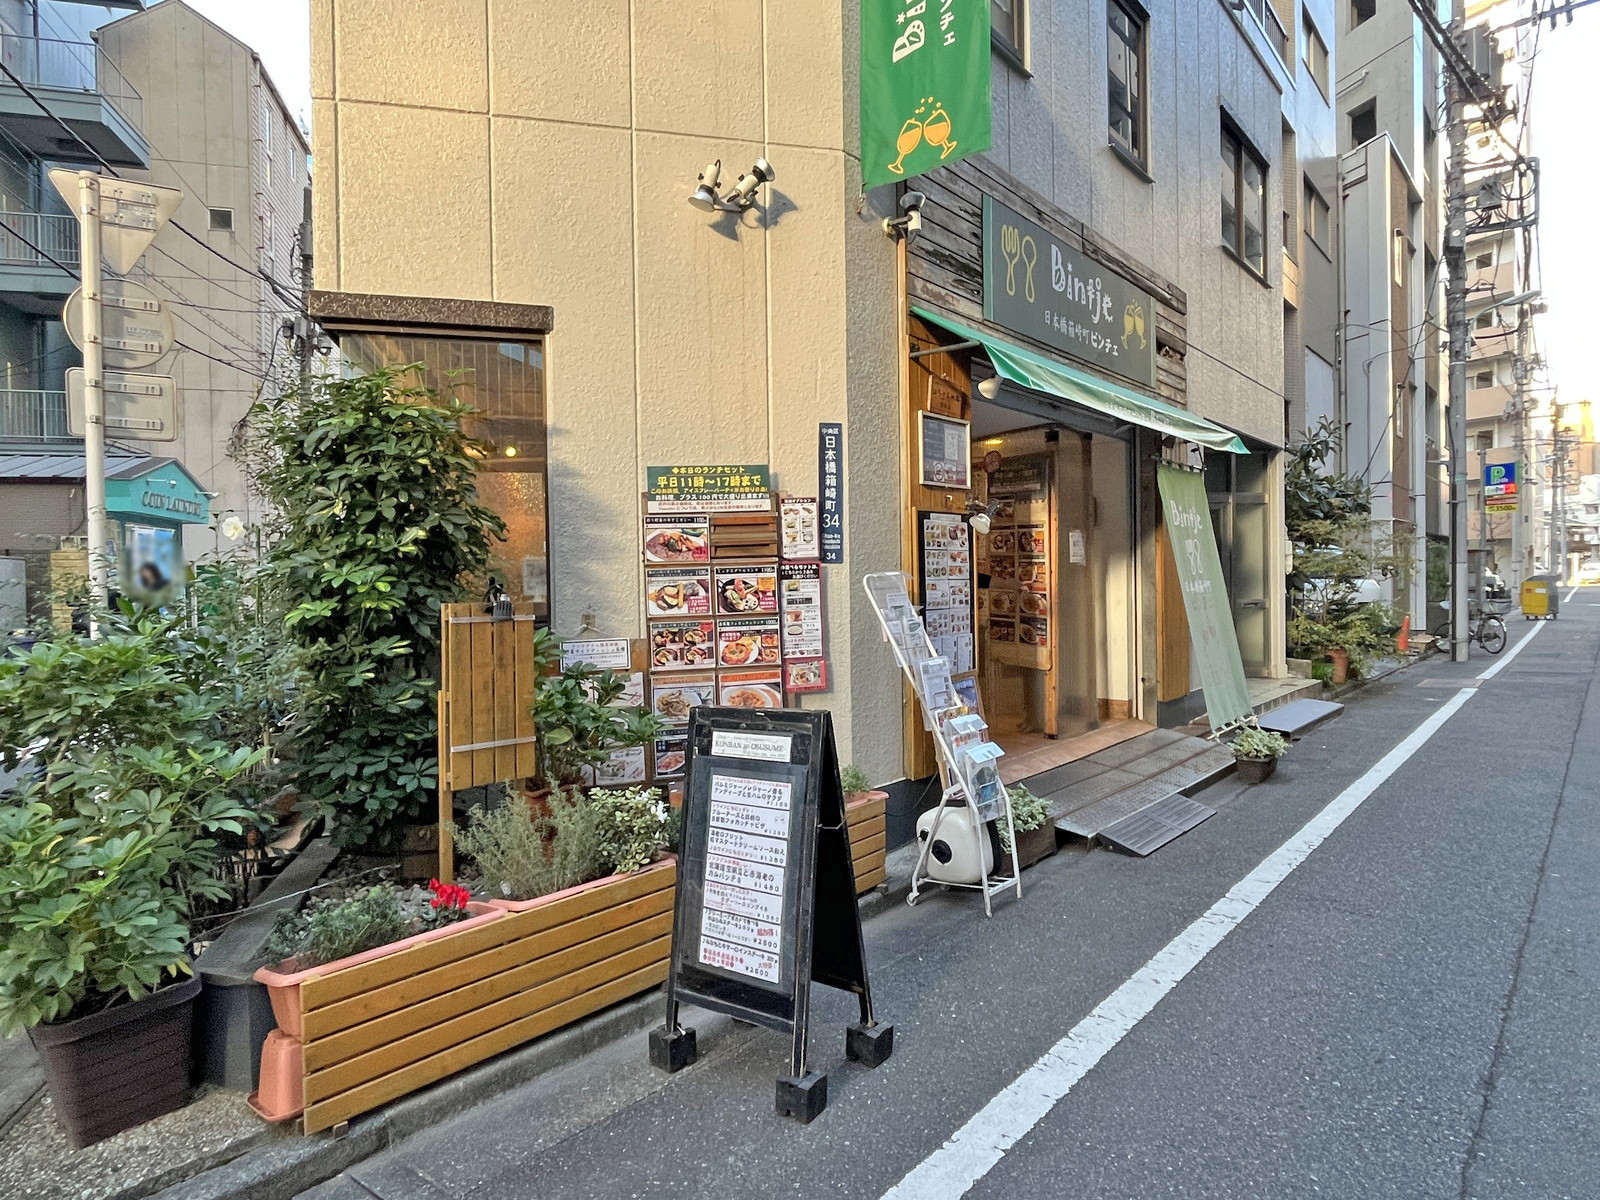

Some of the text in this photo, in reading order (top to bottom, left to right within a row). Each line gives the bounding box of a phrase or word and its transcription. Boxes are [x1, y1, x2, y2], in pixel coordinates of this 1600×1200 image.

[1050, 243, 1114, 324] Bintje
[821, 427, 839, 435] 中央区
[824, 435, 837, 512] 日本橋箱崎町
[822, 513, 840, 528] 34
[1170, 499, 1203, 535] Bintje
[826, 552, 836, 560] 34
[715, 740, 742, 749] KONBAN
[751, 743, 784, 752] OSUSUME
